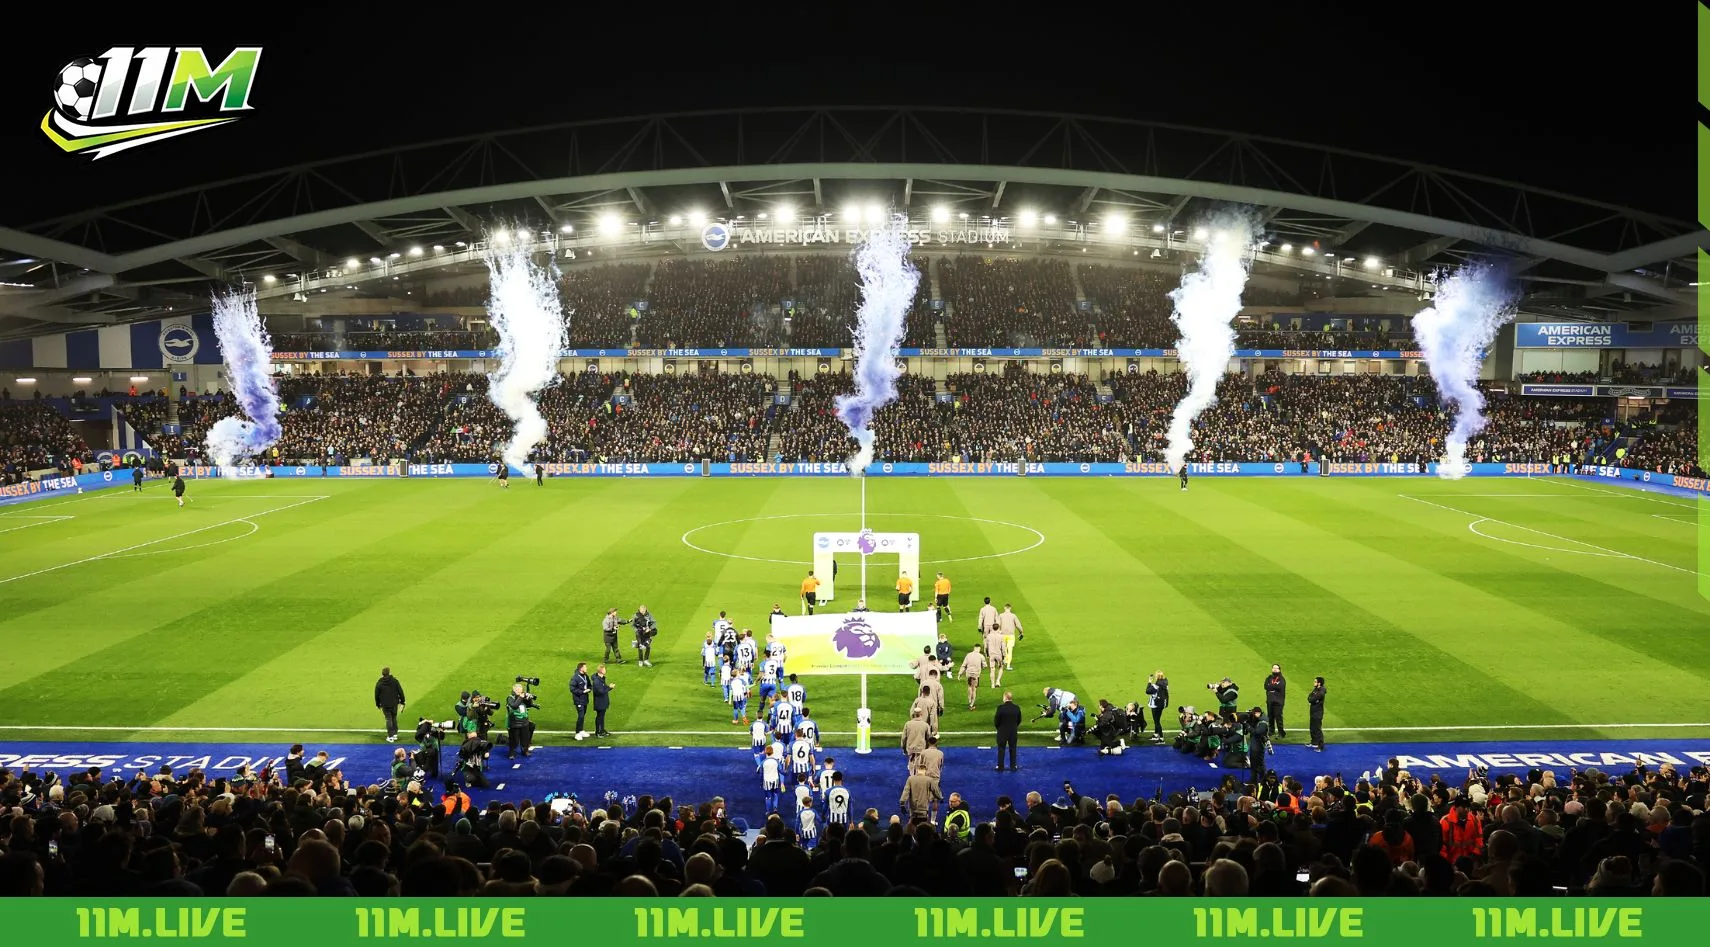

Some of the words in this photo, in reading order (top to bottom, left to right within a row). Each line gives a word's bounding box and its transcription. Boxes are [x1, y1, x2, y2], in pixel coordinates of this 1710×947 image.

[740, 229, 839, 243] AMERICAN
[938, 229, 1009, 243] STADIUM
[1538, 325, 1611, 335] AMERICAN
[1547, 335, 1612, 345] EXPRESS
[271, 351, 298, 359] SUSSEX
[300, 351, 309, 359] BY
[310, 351, 323, 359] THE
[325, 351, 340, 359] SEA
[749, 348, 778, 356] SUSSEX
[778, 348, 789, 356] BY
[790, 348, 805, 356] THE
[806, 348, 821, 356] SEA
[920, 348, 948, 356] SUSSEX
[949, 348, 960, 356] BY
[961, 348, 976, 356] THE
[977, 348, 992, 356] SEA
[1282, 350, 1311, 358] SUSSEX
[1312, 350, 1322, 358] BY
[1323, 350, 1337, 358] THE
[1338, 350, 1352, 358] SEA
[240, 466, 262, 476] SEA
[340, 464, 384, 475] SUSSEX
[430, 464, 454, 475] SEA
[535, 463, 579, 473] USSEX
[581, 463, 598, 473] BY
[600, 463, 621, 473] THE
[626, 463, 649, 473] SEA
[730, 463, 776, 473] SUSSEX
[779, 463, 794, 473] BY
[798, 463, 820, 473] THE
[821, 463, 847, 473] SEA
[928, 463, 975, 473] SUSSEX
[977, 463, 993, 473] BY
[996, 463, 1018, 473] THE
[1125, 463, 1172, 473] SUSSEX
[1192, 463, 1215, 473] THE
[1216, 463, 1240, 473] SEA
[1364, 463, 1380, 473] BY
[1382, 463, 1404, 473] THE
[1505, 464, 1550, 474] SUSSEX
[1599, 465, 1621, 477] SEA
[30, 481, 41, 494] BY
[42, 479, 60, 490] THE
[61, 476, 78, 489] SEA
[1673, 475, 1706, 491] SUSSEX
[724, 633, 737, 643] 23
[740, 647, 750, 658] 13
[769, 664, 775, 675] 3
[791, 691, 802, 701] 18
[779, 709, 790, 720] 41
[797, 746, 806, 758] 6
[1396, 752, 1687, 768] AMERICAN
[835, 794, 845, 807] 9
